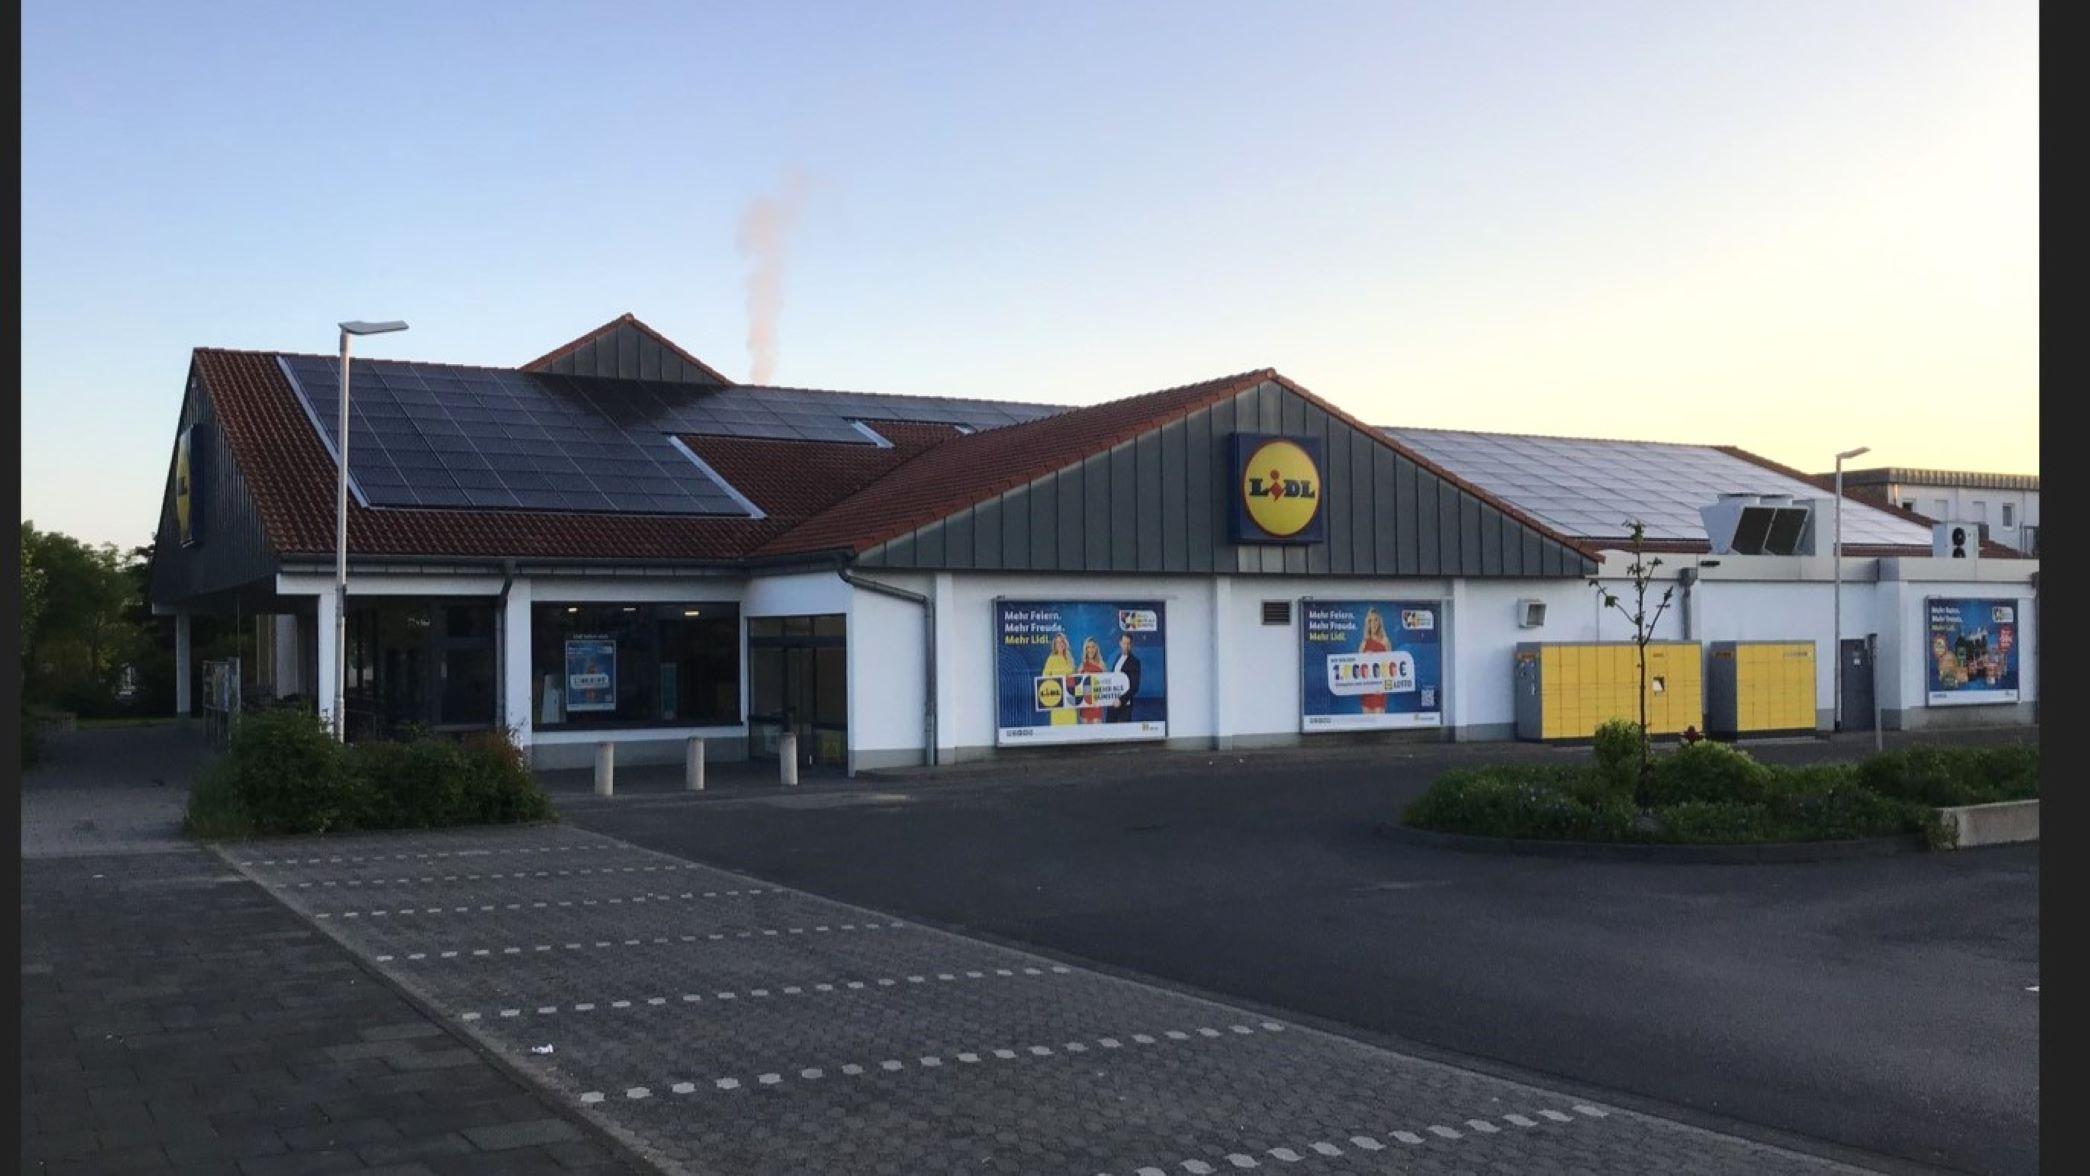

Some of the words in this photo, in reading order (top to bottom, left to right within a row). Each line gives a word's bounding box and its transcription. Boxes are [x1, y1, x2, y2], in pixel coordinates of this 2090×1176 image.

[1004, 610, 1029, 620] Mehr
[1030, 610, 1062, 620] Feiern.
[1309, 610, 1329, 619] Mehr
[1004, 622, 1029, 632] Mehr
[1030, 622, 1065, 632] Freude.
[1309, 621, 1329, 629] Mehr
[1004, 634, 1029, 645] Mehr
[1031, 634, 1051, 644] Lidl.
[1309, 632, 1329, 640] Mehr
[1332, 661, 1397, 681] 1.000000
